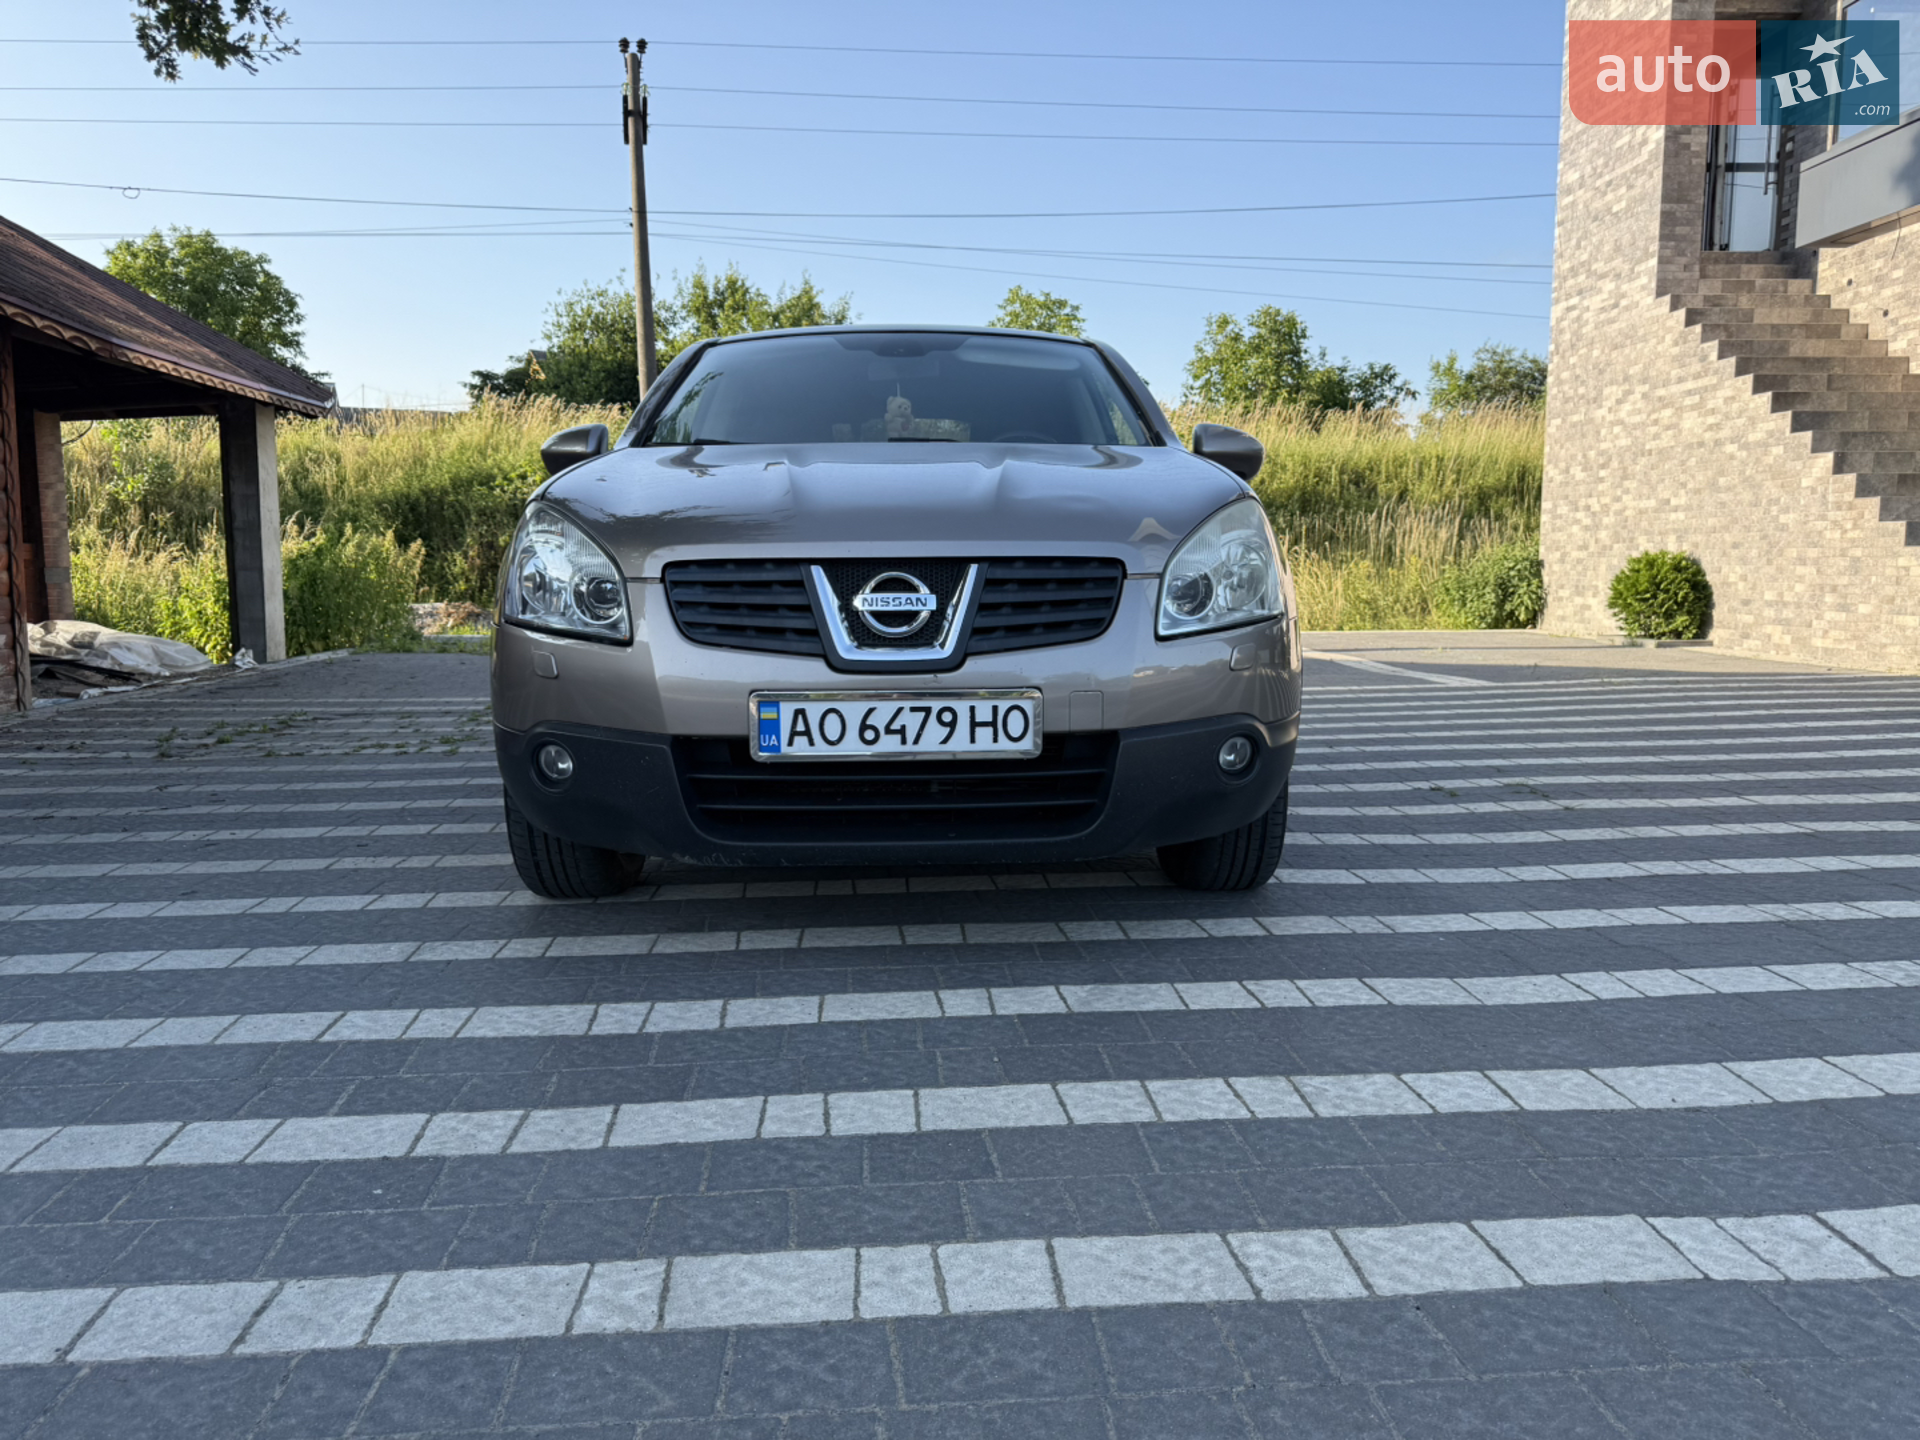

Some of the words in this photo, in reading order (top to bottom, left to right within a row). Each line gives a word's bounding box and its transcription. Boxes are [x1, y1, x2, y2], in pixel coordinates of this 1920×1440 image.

[861, 596, 928, 607] NISSAN
[786, 707, 847, 747] AO
[858, 705, 959, 746] 6479
[969, 704, 1030, 744] HO
[760, 735, 780, 747] UA
